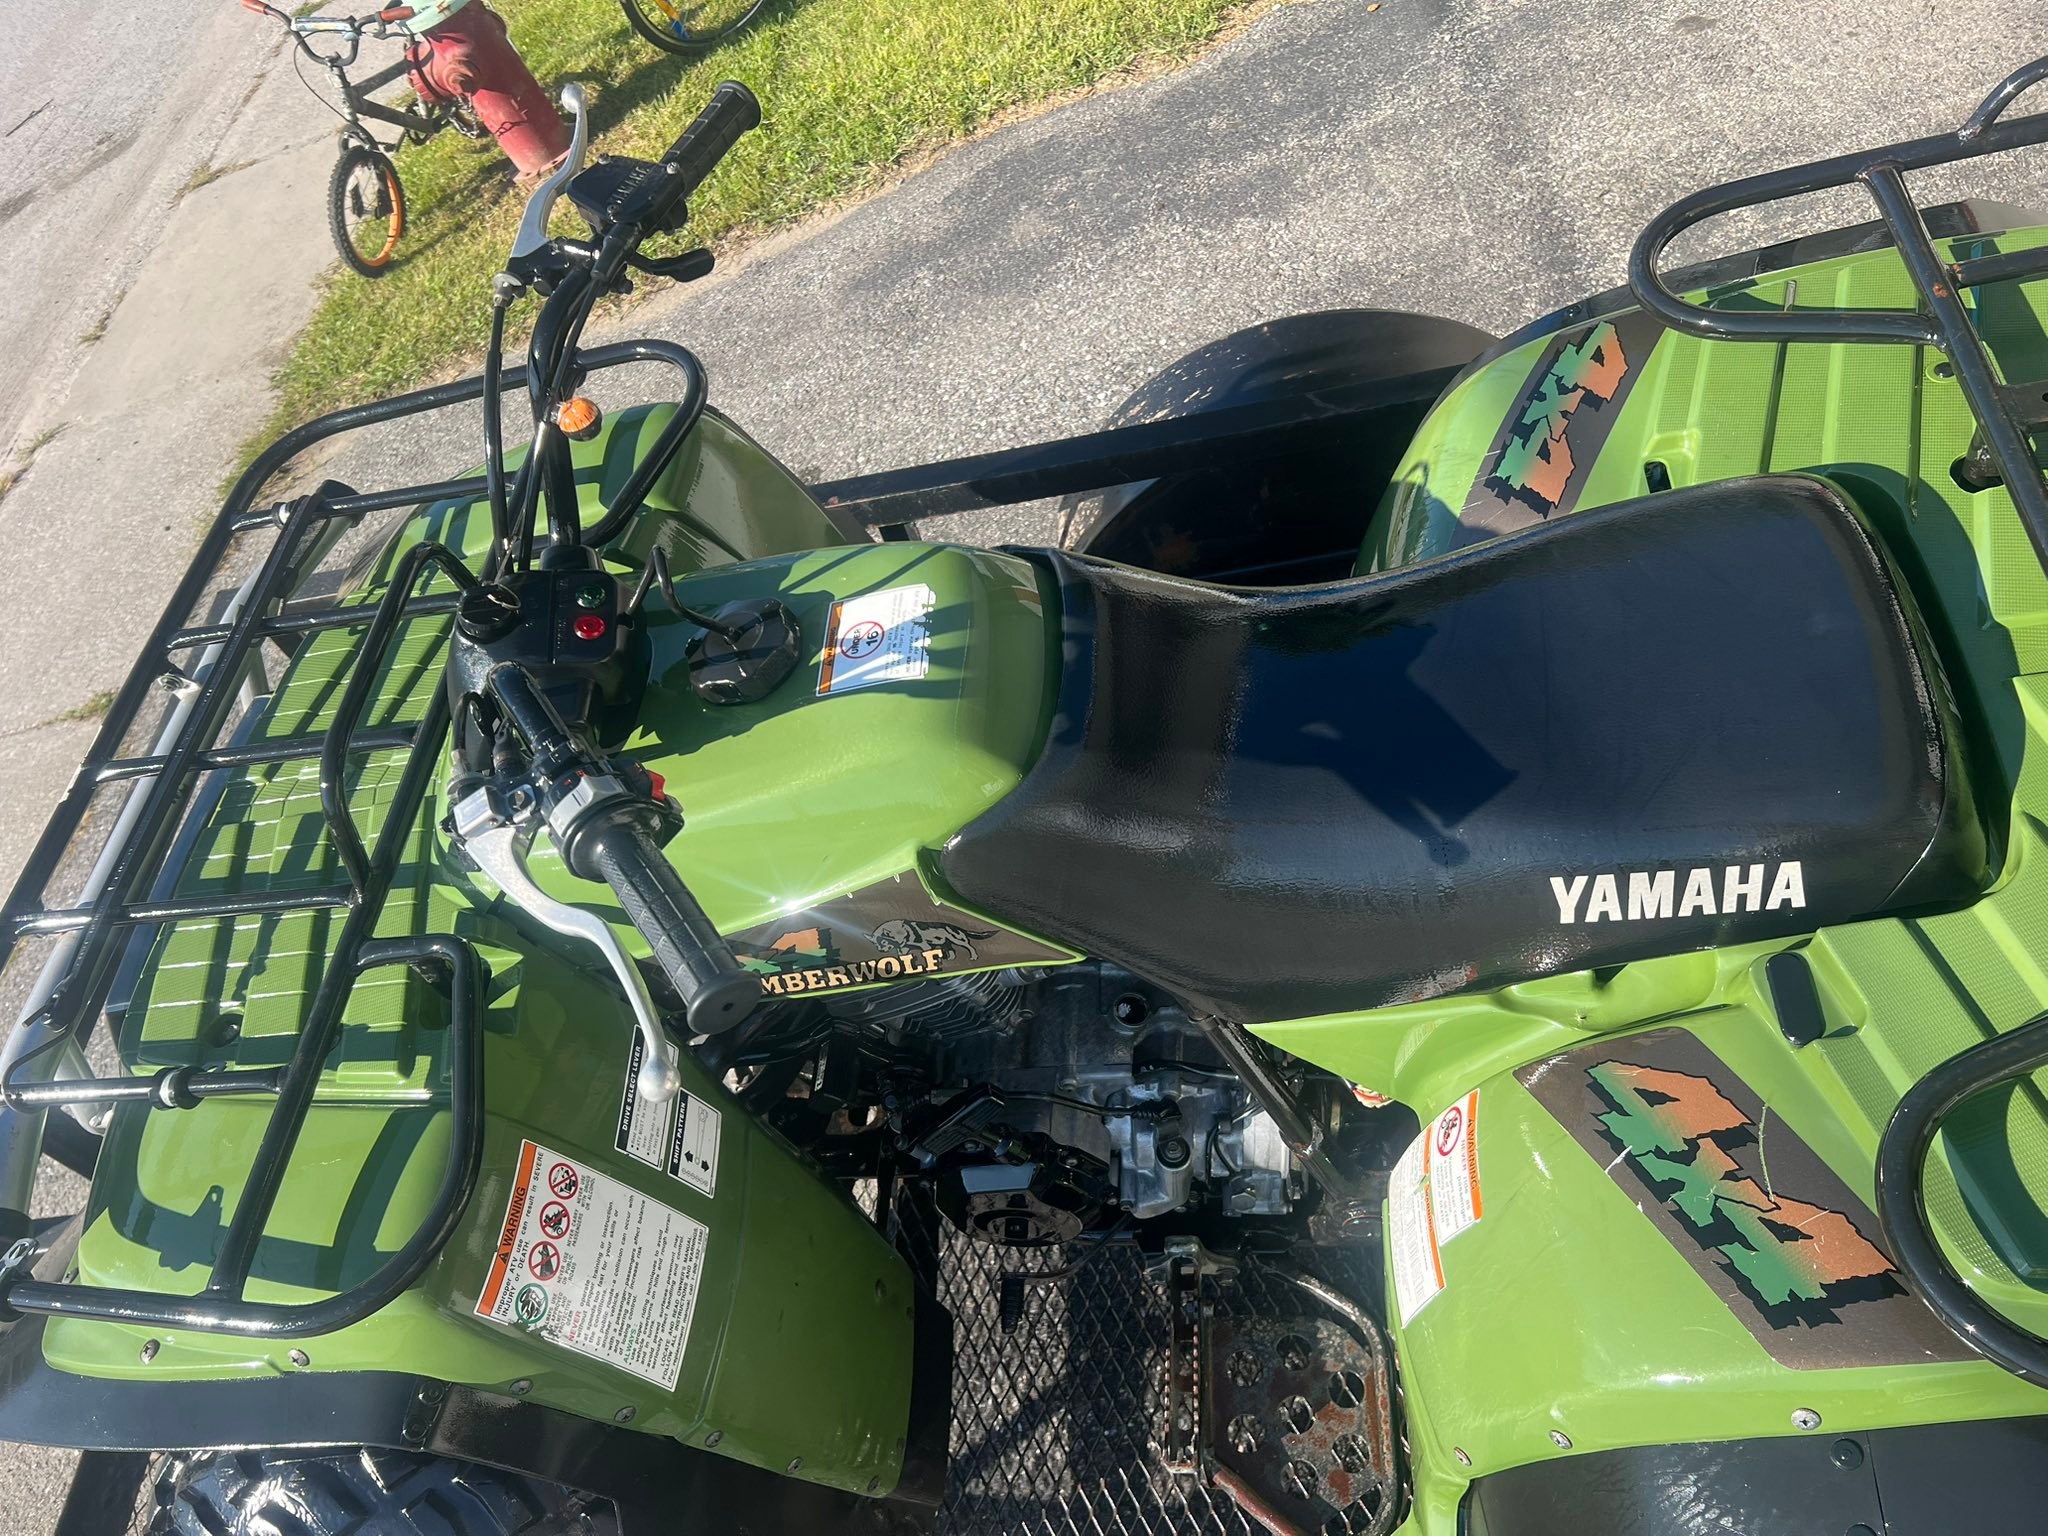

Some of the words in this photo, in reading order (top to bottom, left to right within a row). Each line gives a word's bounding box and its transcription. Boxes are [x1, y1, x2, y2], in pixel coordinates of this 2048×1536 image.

[865, 629, 878, 646] 16
[1549, 860, 1806, 924] YAMAHA
[760, 949, 943, 995] MBERWOLF
[632, 1045, 640, 1071] LEVER
[626, 1072, 636, 1103] SELECT
[622, 1104, 631, 1130] DRIVE
[676, 1101, 685, 1138] PATTERN
[532, 1151, 543, 1181] SEVERE
[1466, 1129, 1477, 1190] WARNING
[525, 1195, 534, 1217] result
[530, 1184, 536, 1192] in
[501, 1186, 525, 1245] WARNING
[566, 1228, 574, 1246] NEVER
[509, 1256, 517, 1273] ATV
[556, 1265, 565, 1283] NEVER
[561, 1276, 567, 1284] ON
[564, 1254, 573, 1274] PUBLIC
[568, 1262, 576, 1280] ROADS
[583, 1333, 588, 1341] at
[586, 1304, 596, 1330] speeds
[613, 1209, 618, 1217] or
[607, 1335, 615, 1350] with
[637, 1199, 645, 1224] balance
[494, 1277, 511, 1315] Improper
[501, 1285, 516, 1316] INJURY
[514, 1272, 520, 1281] or
[576, 1310, 587, 1337] without
[585, 1281, 595, 1306] proper
[591, 1251, 603, 1279] training
[595, 1336, 601, 1346] on
[599, 1311, 608, 1333] public
[613, 1247, 623, 1276] collision
[617, 1308, 628, 1336] steering
[628, 1261, 639, 1289] increase
[634, 1321, 643, 1344] proper
[641, 1298, 649, 1318] riding
[646, 1260, 657, 1295] techniques
[543, 1307, 553, 1327] LWAYS
[567, 1310, 581, 1341] NEVER
[601, 1320, 612, 1348] another
[620, 1322, 630, 1345] losing
[635, 1337, 644, 1362] vehicle
[642, 1302, 653, 1335] overturns
[651, 1290, 655, 1299] on
[651, 1336, 663, 1369] seriously
[660, 1313, 668, 1333] affect
[665, 1279, 676, 1309] handling
[660, 1338, 670, 1366] LOCATE
[671, 1299, 679, 1318] READ
[662, 1349, 672, 1380] FOLLOW
[674, 1282, 688, 1331] INSTRUCTIONS
[618, 1347, 623, 1355] of
[646, 1346, 654, 1367] avoid
[652, 1321, 661, 1343] paved
[672, 1325, 684, 1366] replacement
